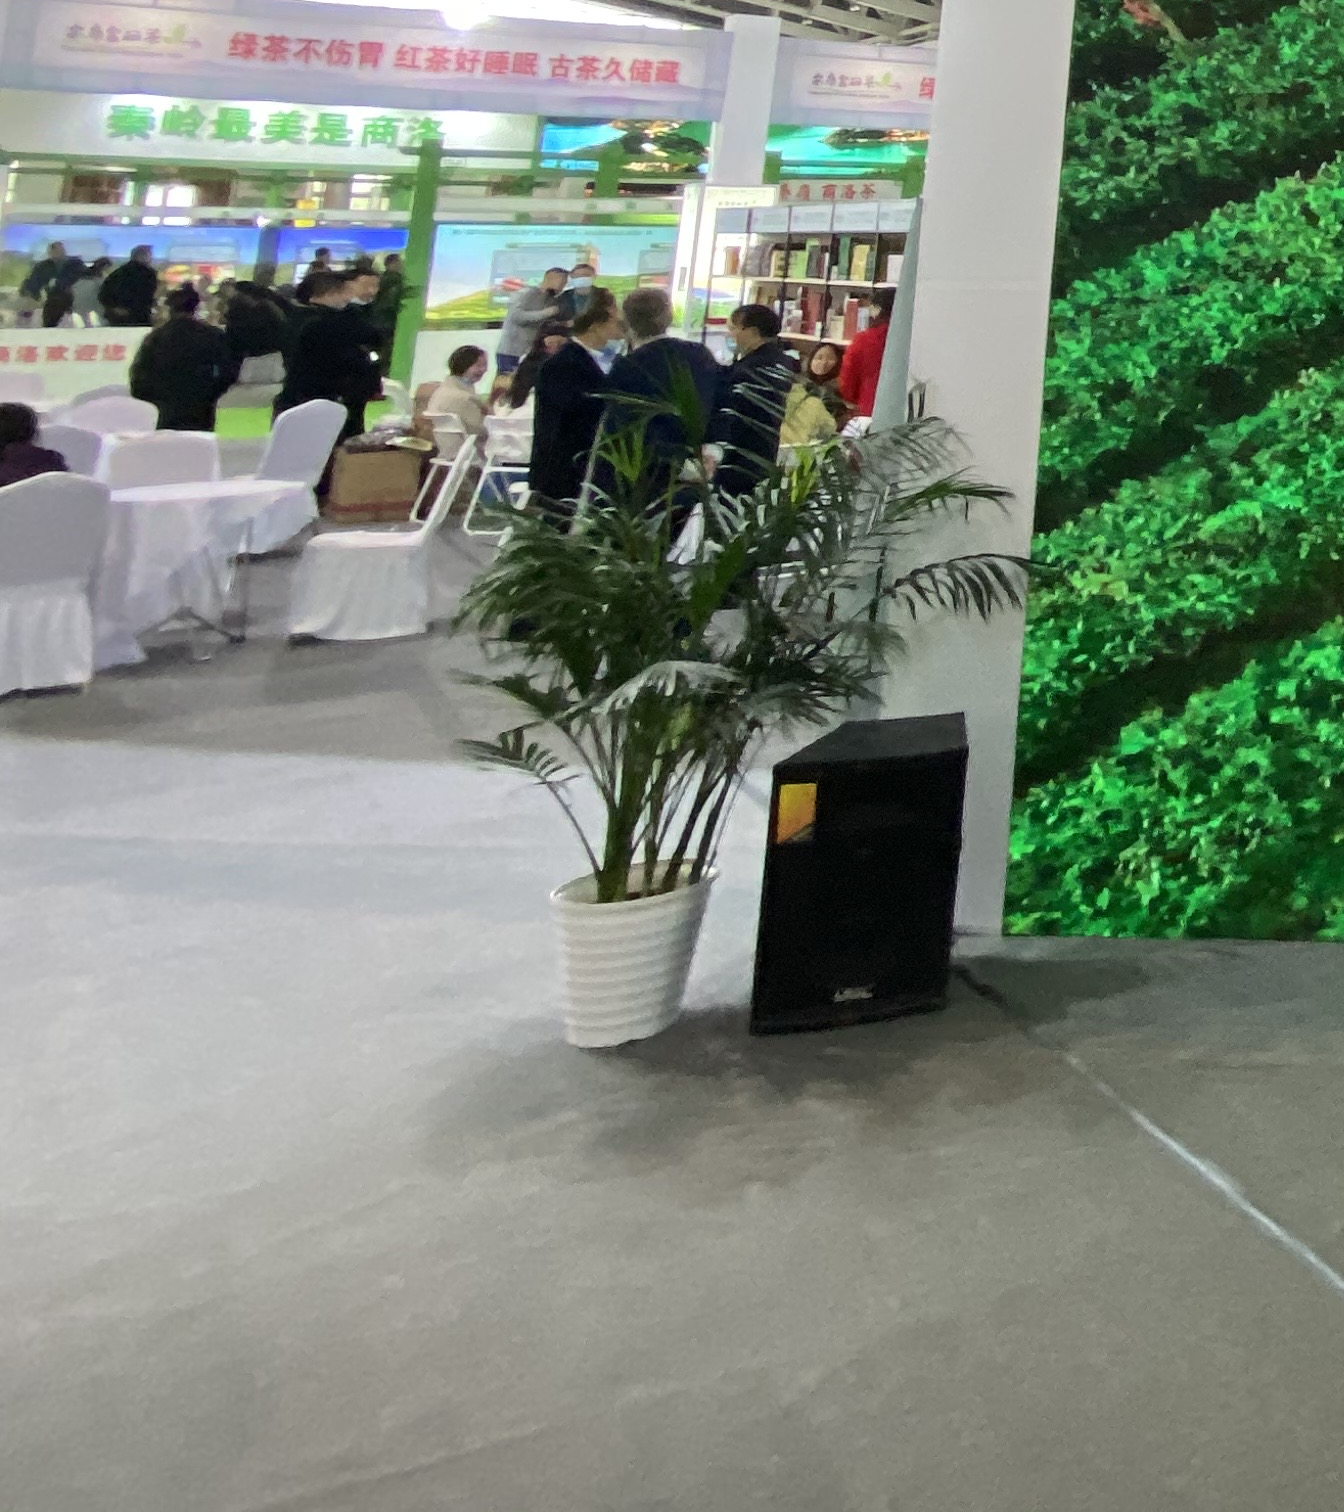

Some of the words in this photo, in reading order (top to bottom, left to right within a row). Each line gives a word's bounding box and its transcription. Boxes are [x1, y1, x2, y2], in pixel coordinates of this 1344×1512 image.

[228, 31, 385, 70] 绿茶不伤胃
[394, 44, 539, 78] 红茶好睡眠
[549, 54, 682, 86] 古茶久储藏
